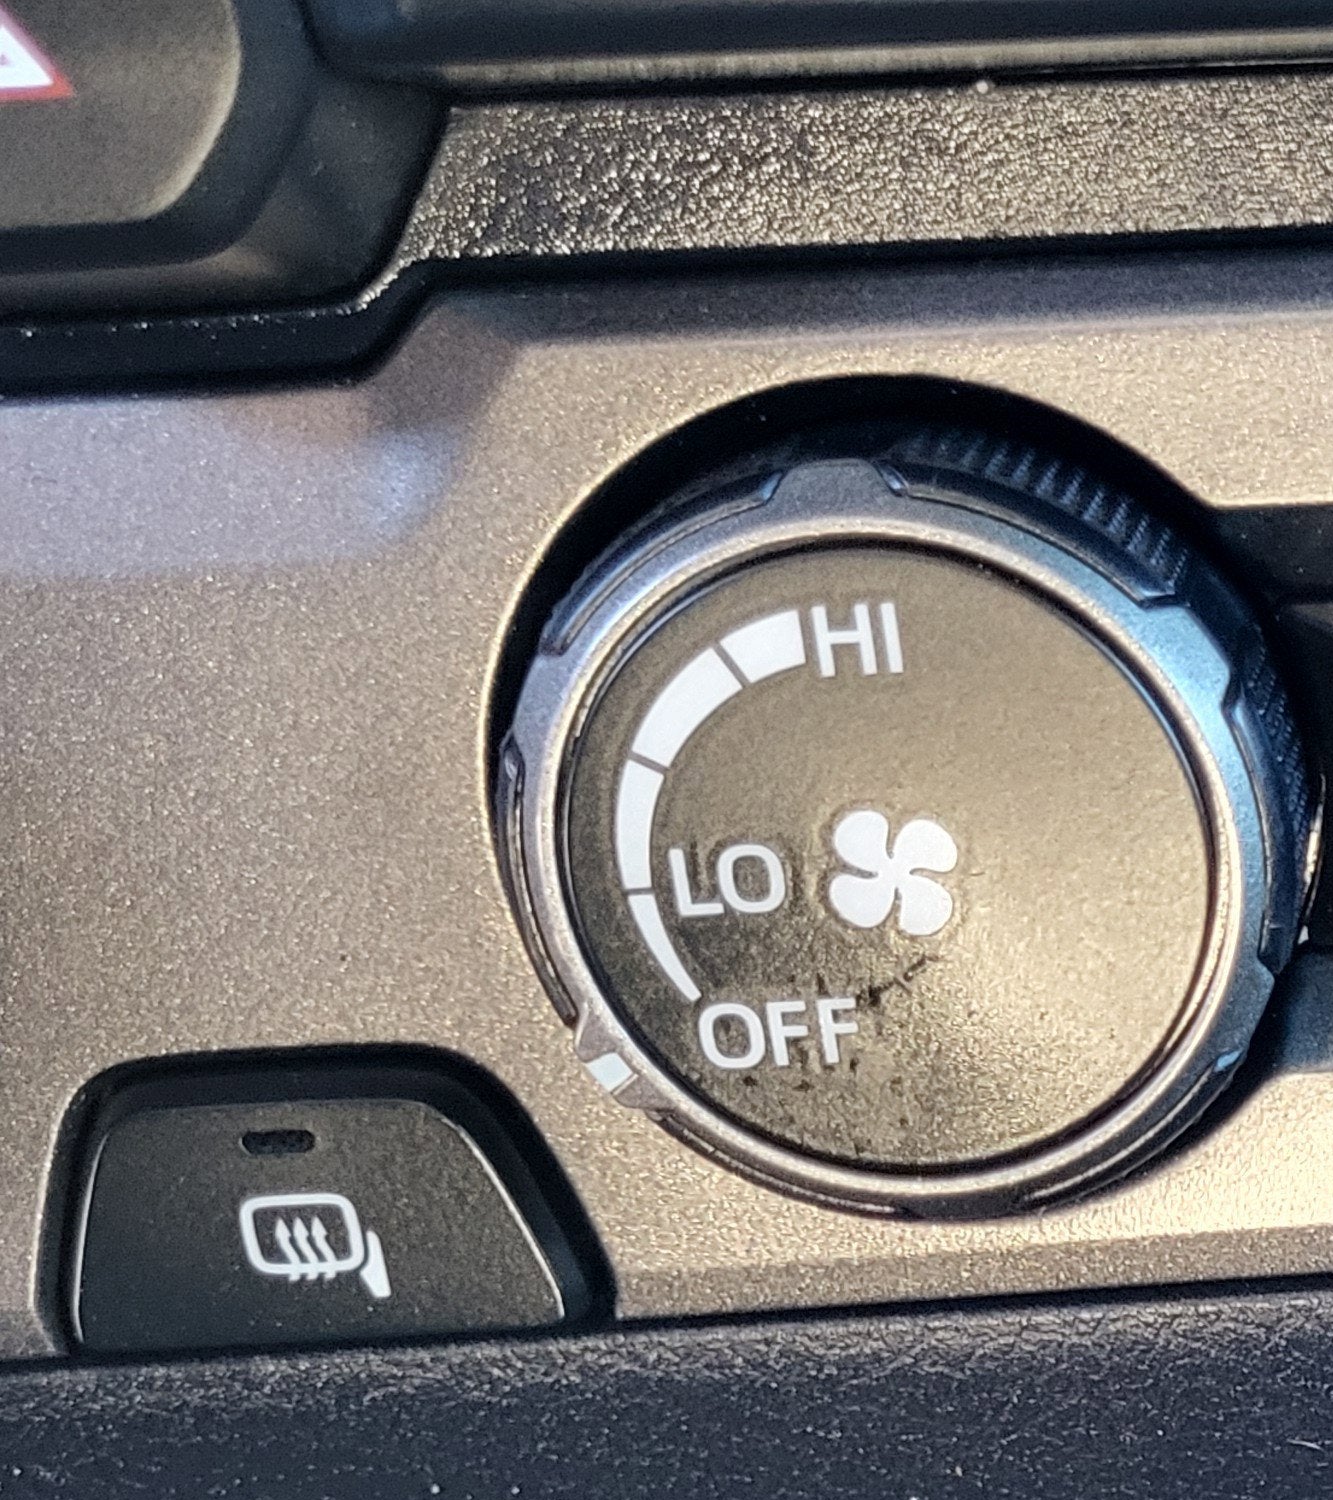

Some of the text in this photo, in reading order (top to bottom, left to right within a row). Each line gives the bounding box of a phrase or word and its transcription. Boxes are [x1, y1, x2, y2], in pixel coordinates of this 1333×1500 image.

[811, 602, 903, 678] HI
[669, 843, 786, 917] LO
[700, 998, 859, 1070] OFF
